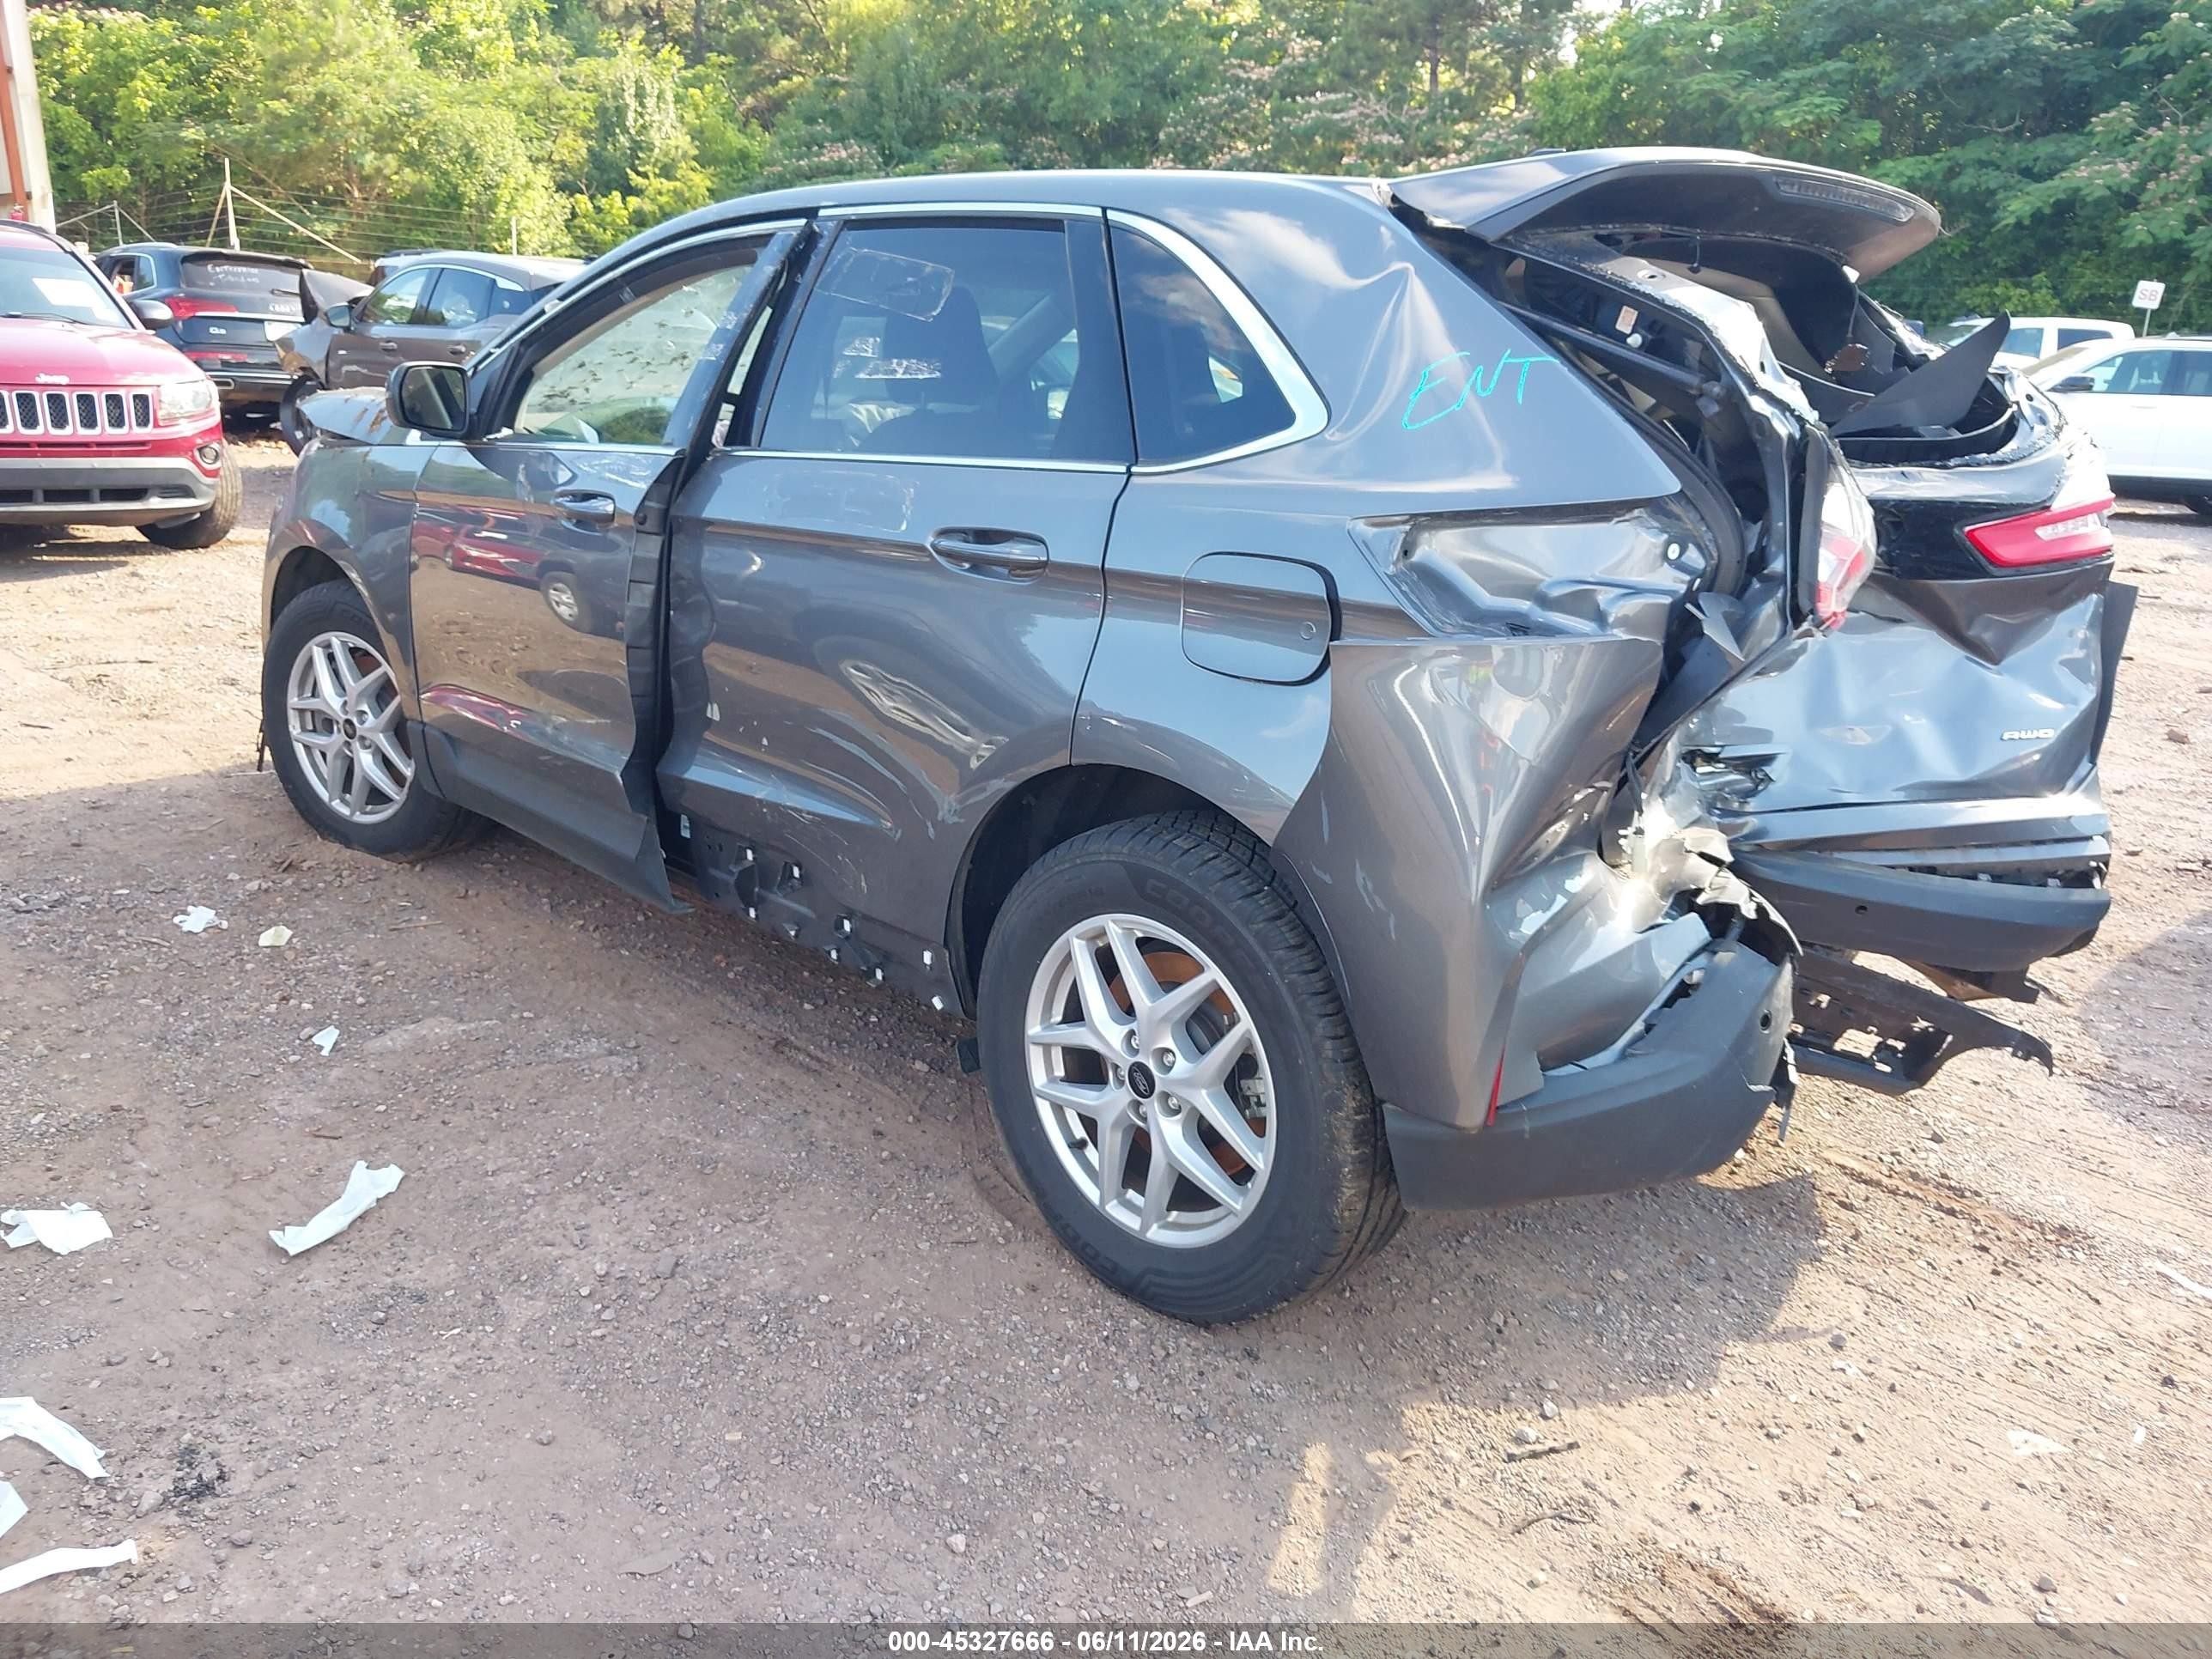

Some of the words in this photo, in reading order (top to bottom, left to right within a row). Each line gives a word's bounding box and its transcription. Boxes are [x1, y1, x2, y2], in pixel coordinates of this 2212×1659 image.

[2138, 289, 2158, 301] SB
[1401, 348, 1560, 430] ENT
[2001, 728, 2055, 740] AWD
